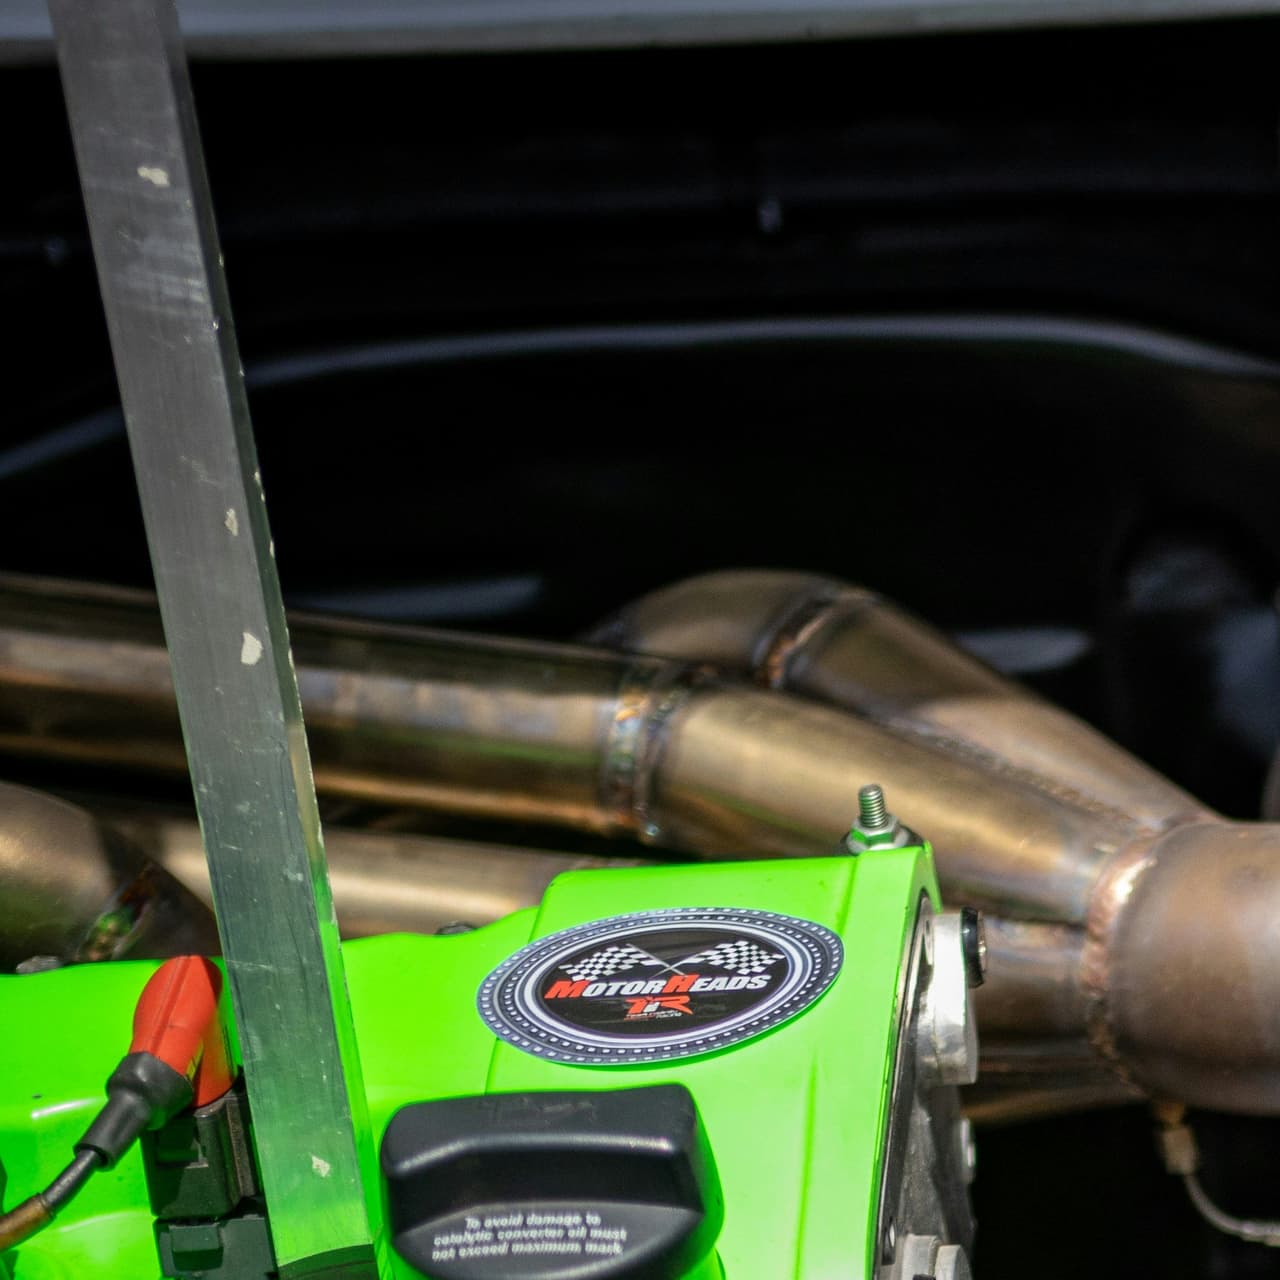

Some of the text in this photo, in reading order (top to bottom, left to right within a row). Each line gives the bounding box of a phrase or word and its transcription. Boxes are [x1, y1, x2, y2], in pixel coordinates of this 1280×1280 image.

[465, 1211, 601, 1228] To avoid damage to
[433, 1226, 627, 1248] catalytic converter oil must
[431, 1246, 455, 1261] not
[458, 1241, 509, 1258] exceed
[511, 1240, 582, 1254] maximum
